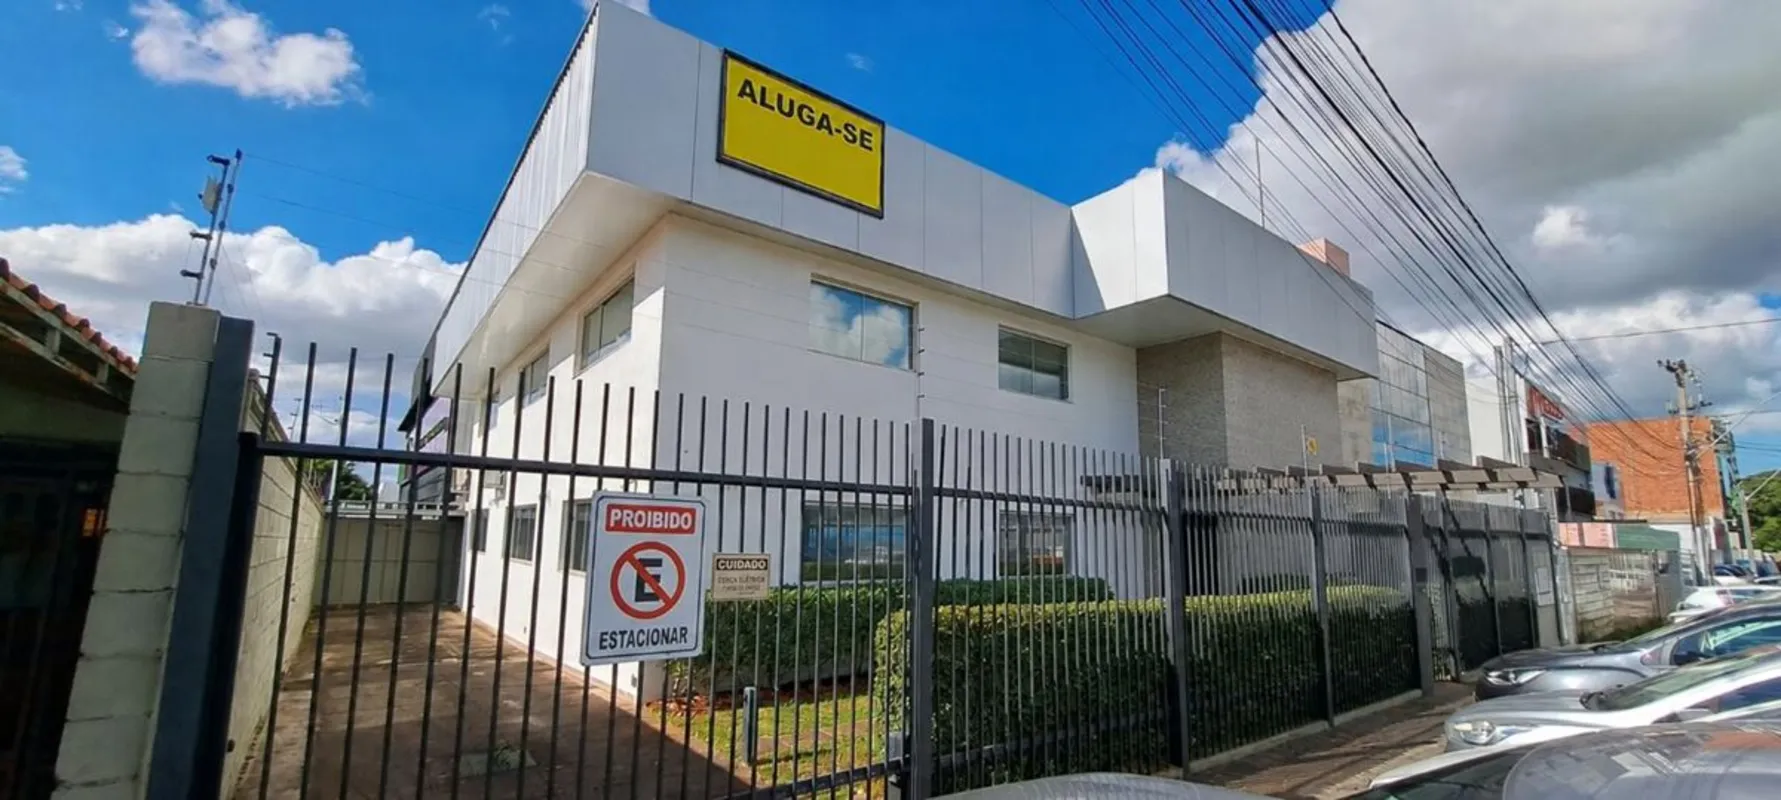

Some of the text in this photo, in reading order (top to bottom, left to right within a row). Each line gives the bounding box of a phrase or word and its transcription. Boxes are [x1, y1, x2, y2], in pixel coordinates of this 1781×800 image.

[738, 78, 873, 151] ALUGA-SE
[610, 508, 692, 530] PROIBIDO
[717, 560, 767, 569] CUIDADO
[635, 557, 663, 602] E
[599, 626, 688, 650] ESTACIONAR
